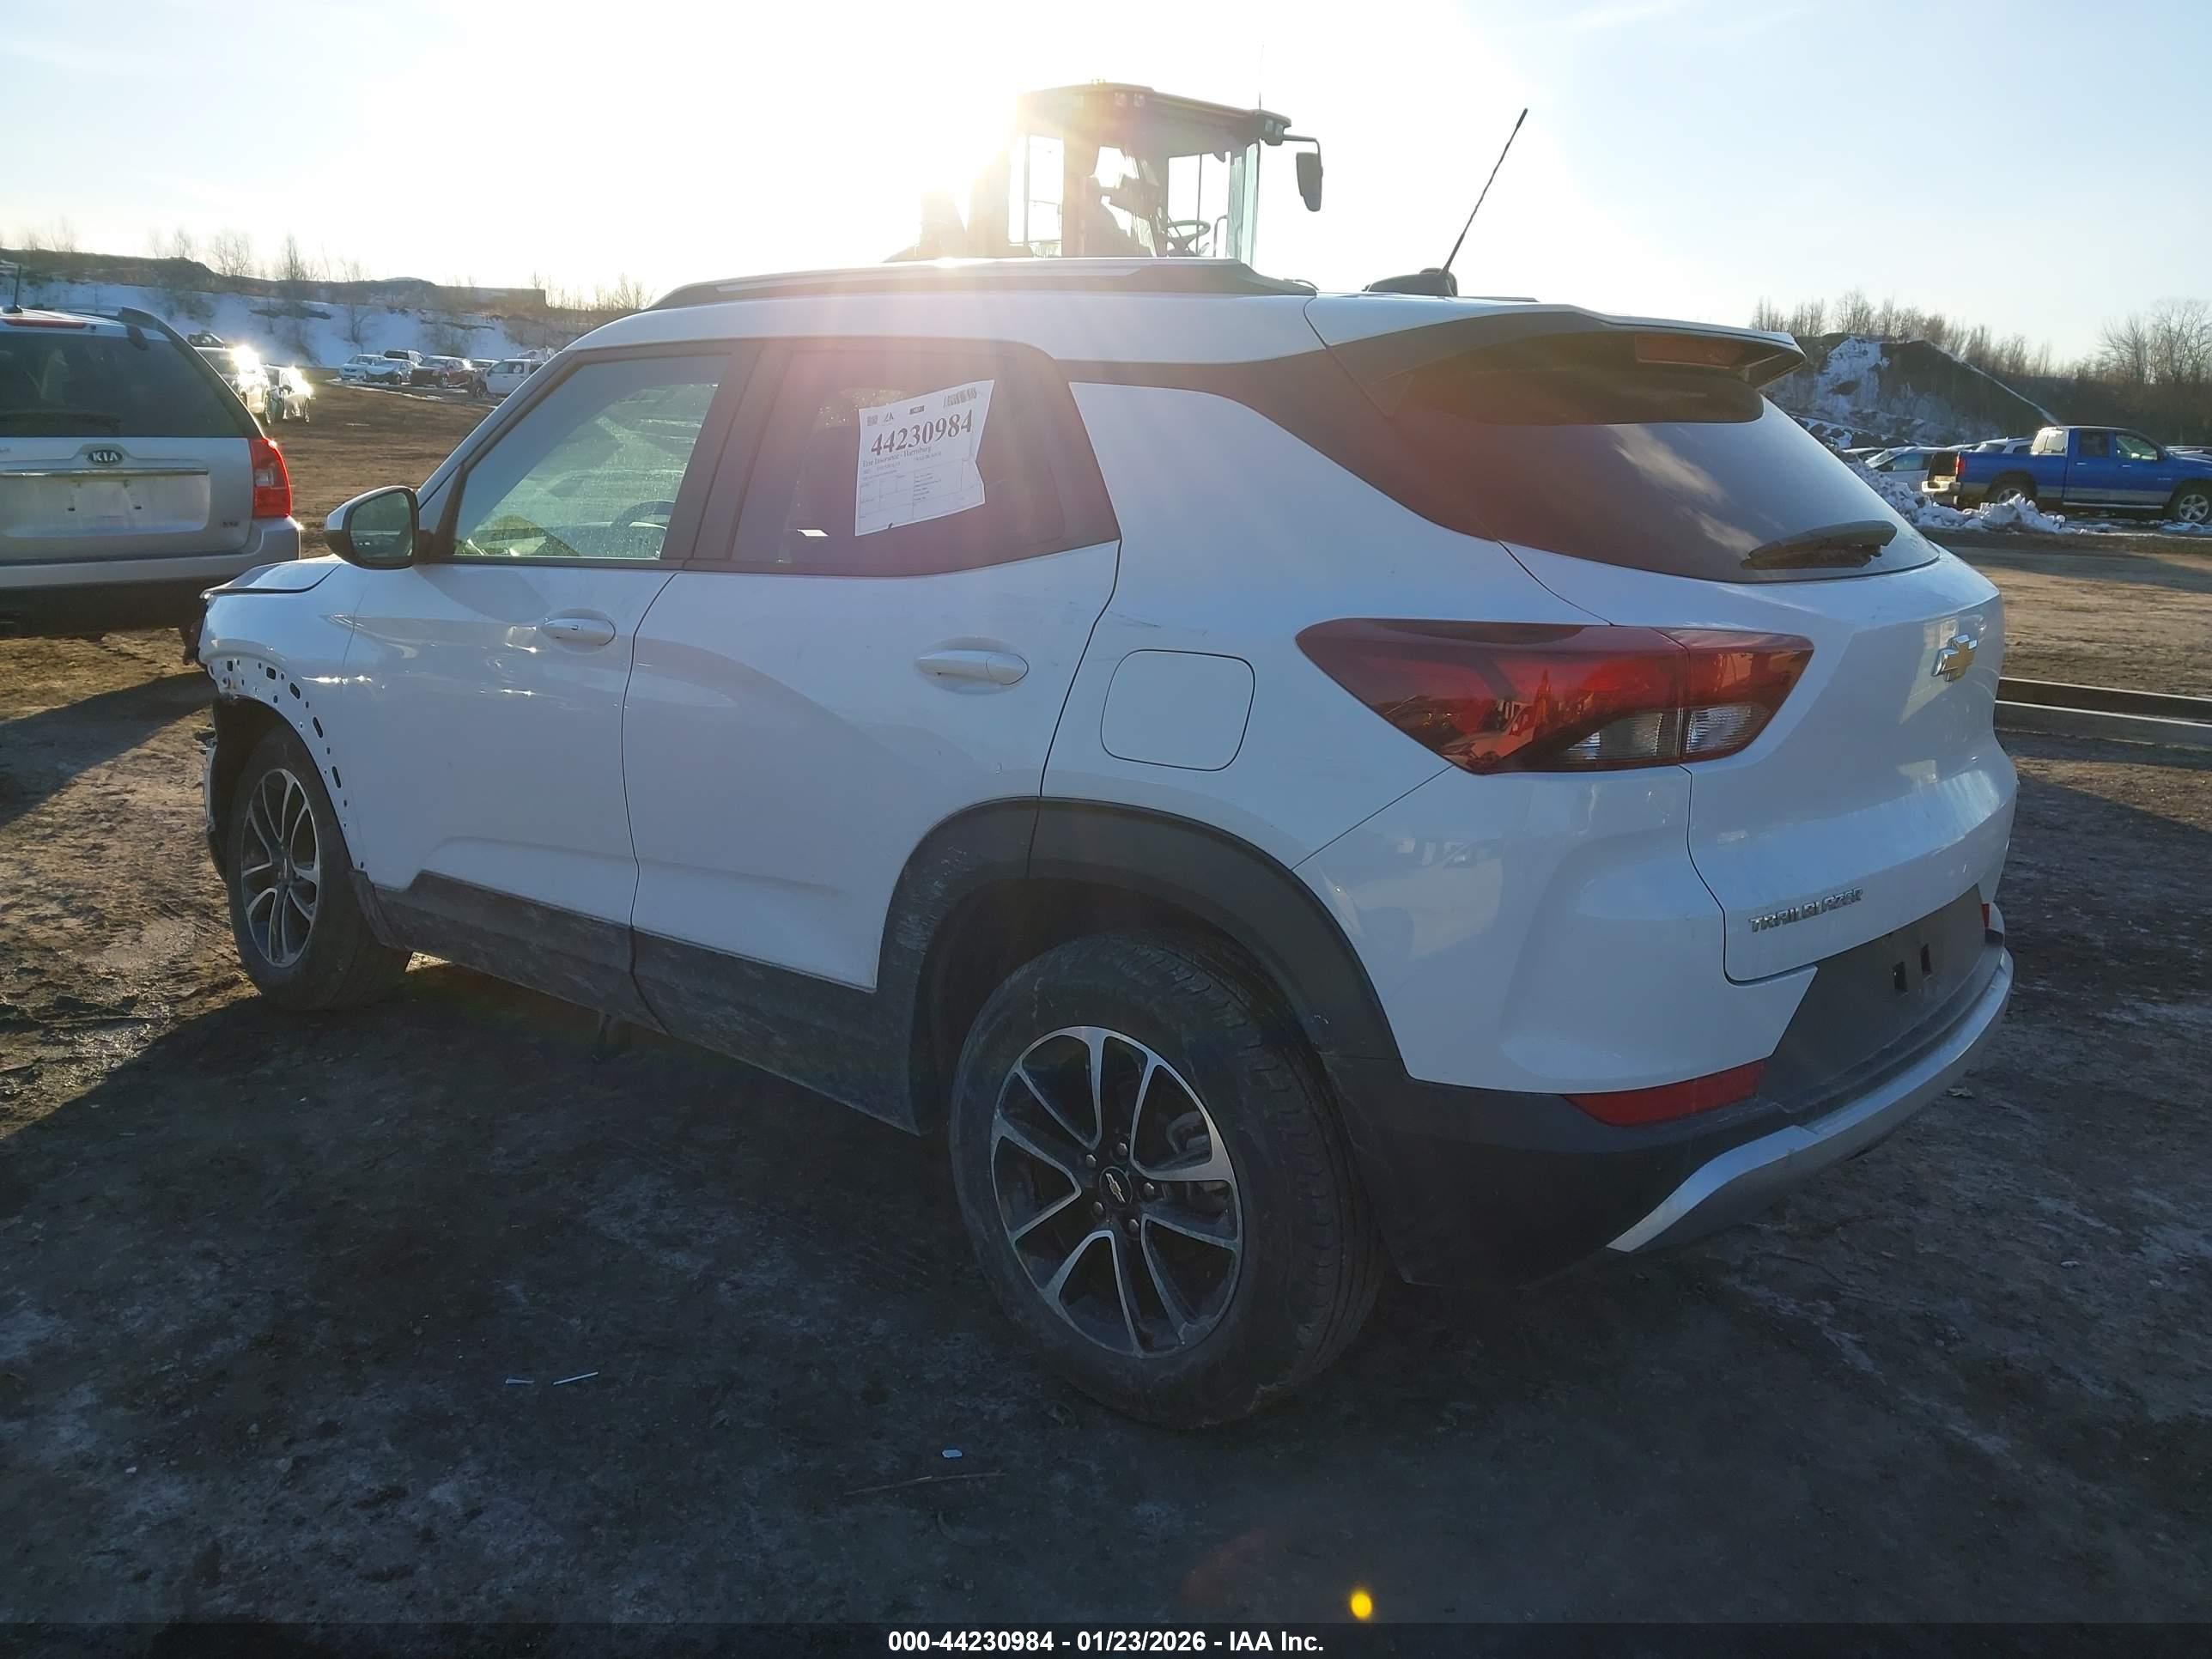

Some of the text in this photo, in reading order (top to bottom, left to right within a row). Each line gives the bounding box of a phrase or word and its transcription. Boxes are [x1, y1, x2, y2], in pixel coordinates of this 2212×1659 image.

[871, 410, 972, 455] 44230984
[92, 452, 118, 462] KIA
[1748, 886, 1863, 933] TRAILBLAZER
